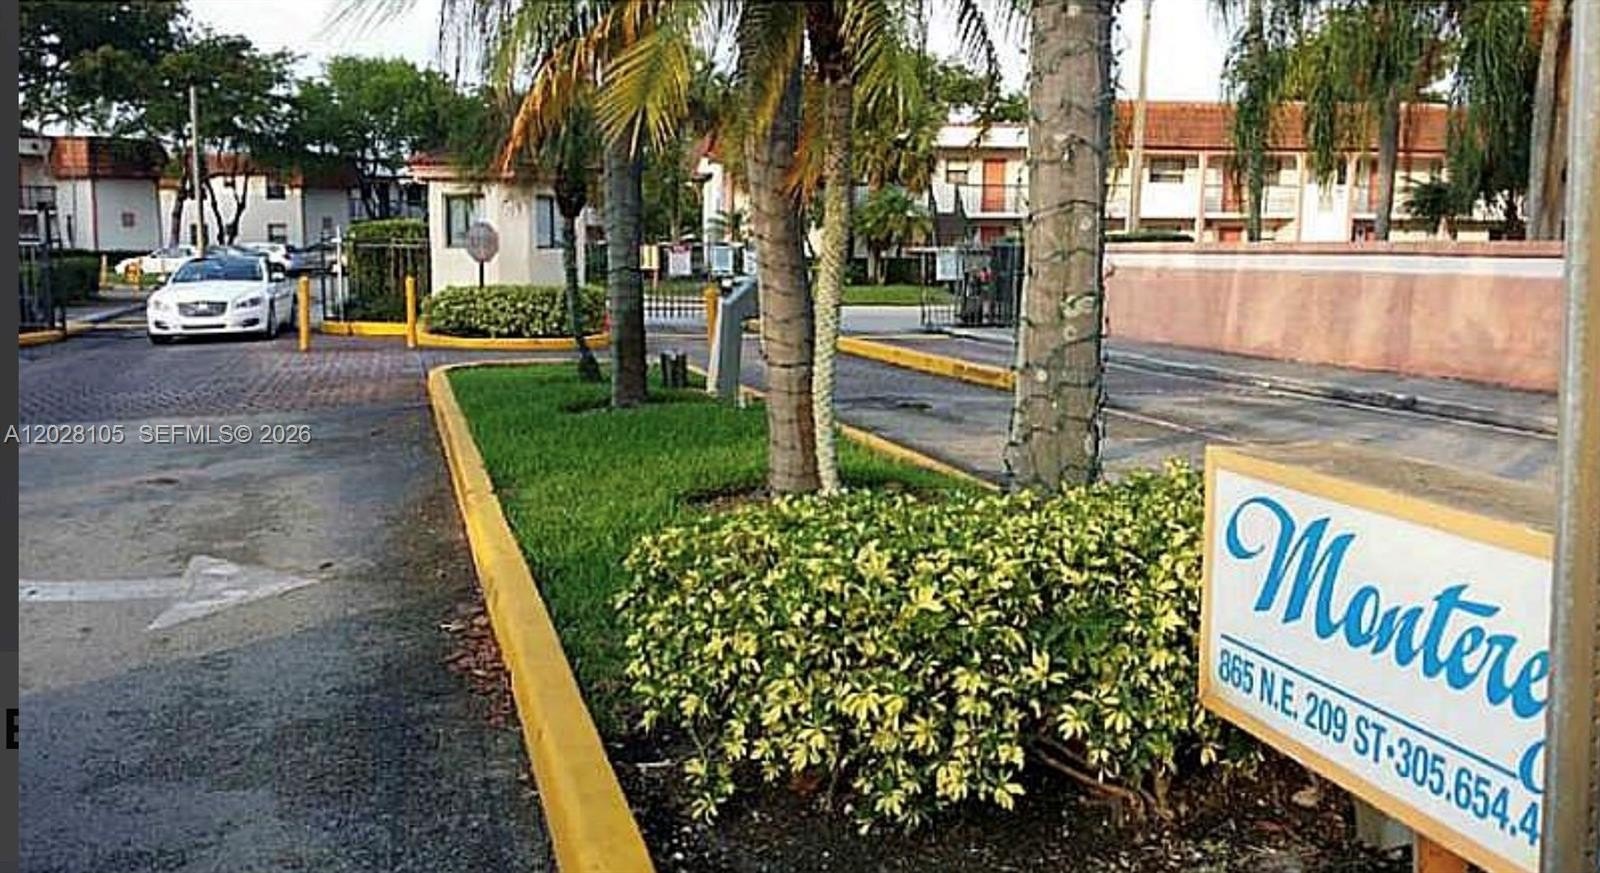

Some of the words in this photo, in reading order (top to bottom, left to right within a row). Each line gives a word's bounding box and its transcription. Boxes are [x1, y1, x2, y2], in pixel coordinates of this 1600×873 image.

[1219, 648, 1255, 695] 865
[1260, 667, 1298, 720] N.E.
[1304, 691, 1348, 744] 209
